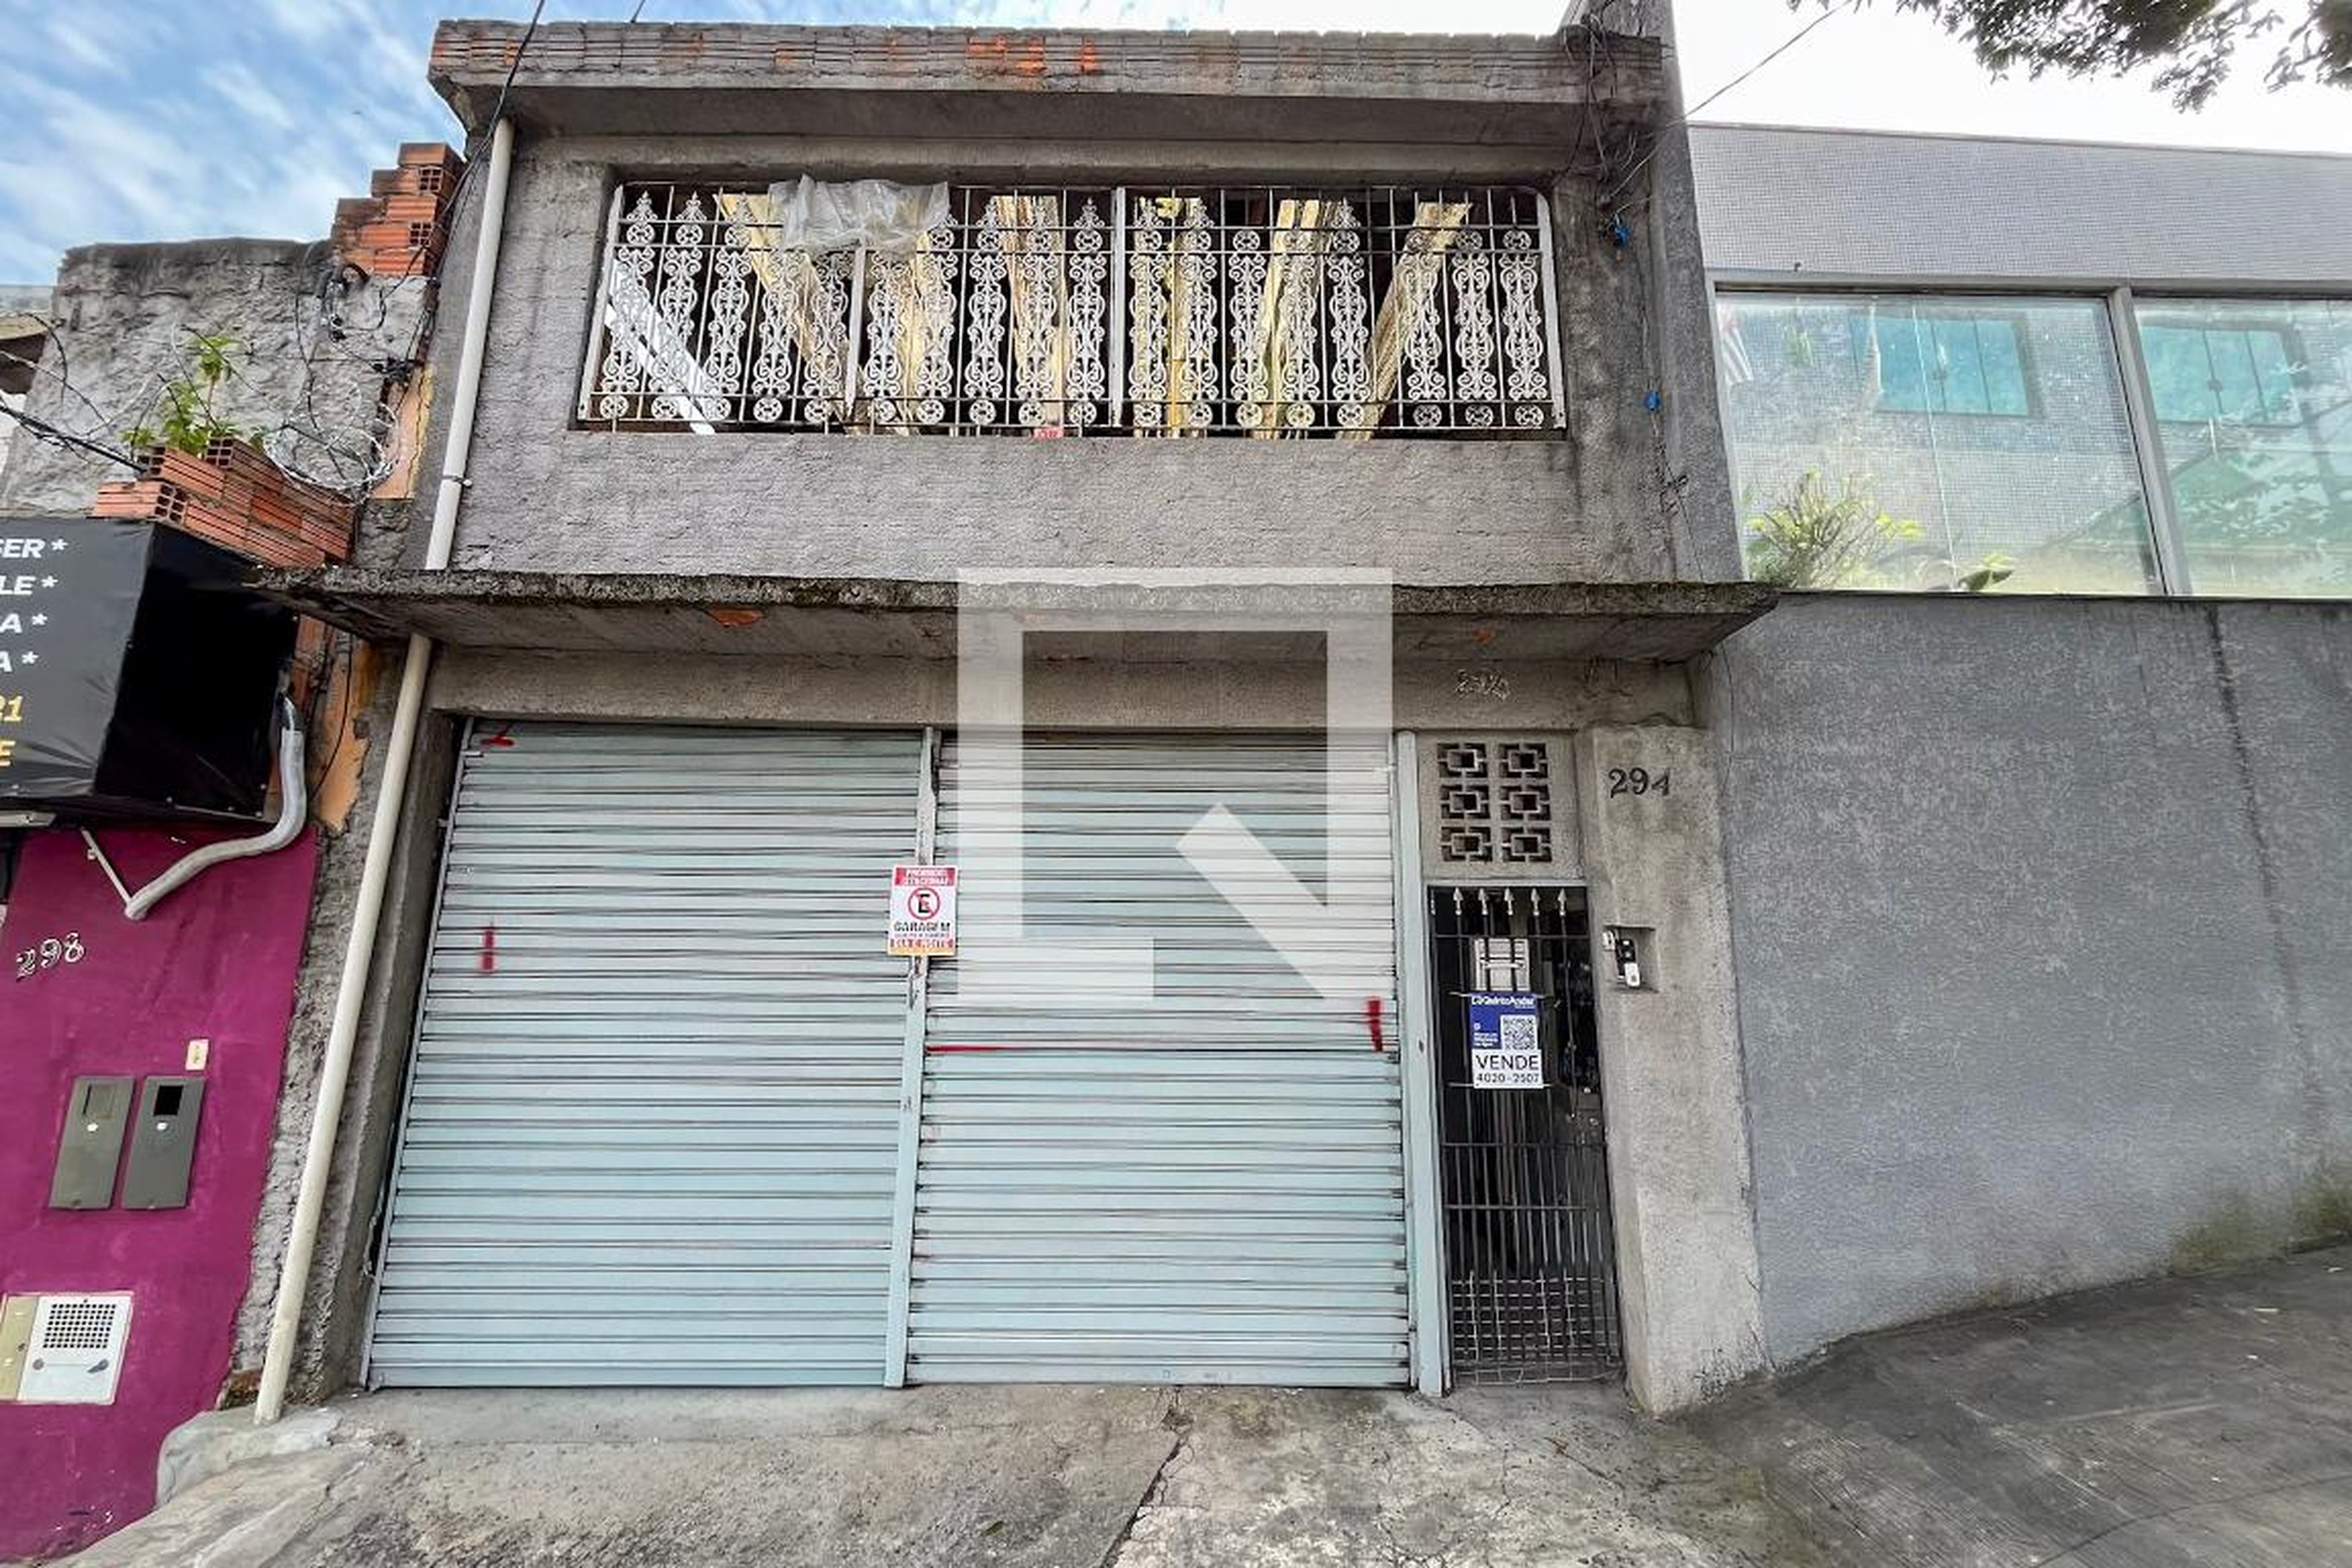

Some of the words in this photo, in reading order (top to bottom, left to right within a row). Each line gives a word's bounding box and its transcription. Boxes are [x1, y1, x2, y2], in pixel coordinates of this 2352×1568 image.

[0, 538, 46, 559] ER
[1608, 767, 1670, 799] 294
[16, 932, 85, 981] 298
[1475, 1055, 1539, 1071] VENDE
